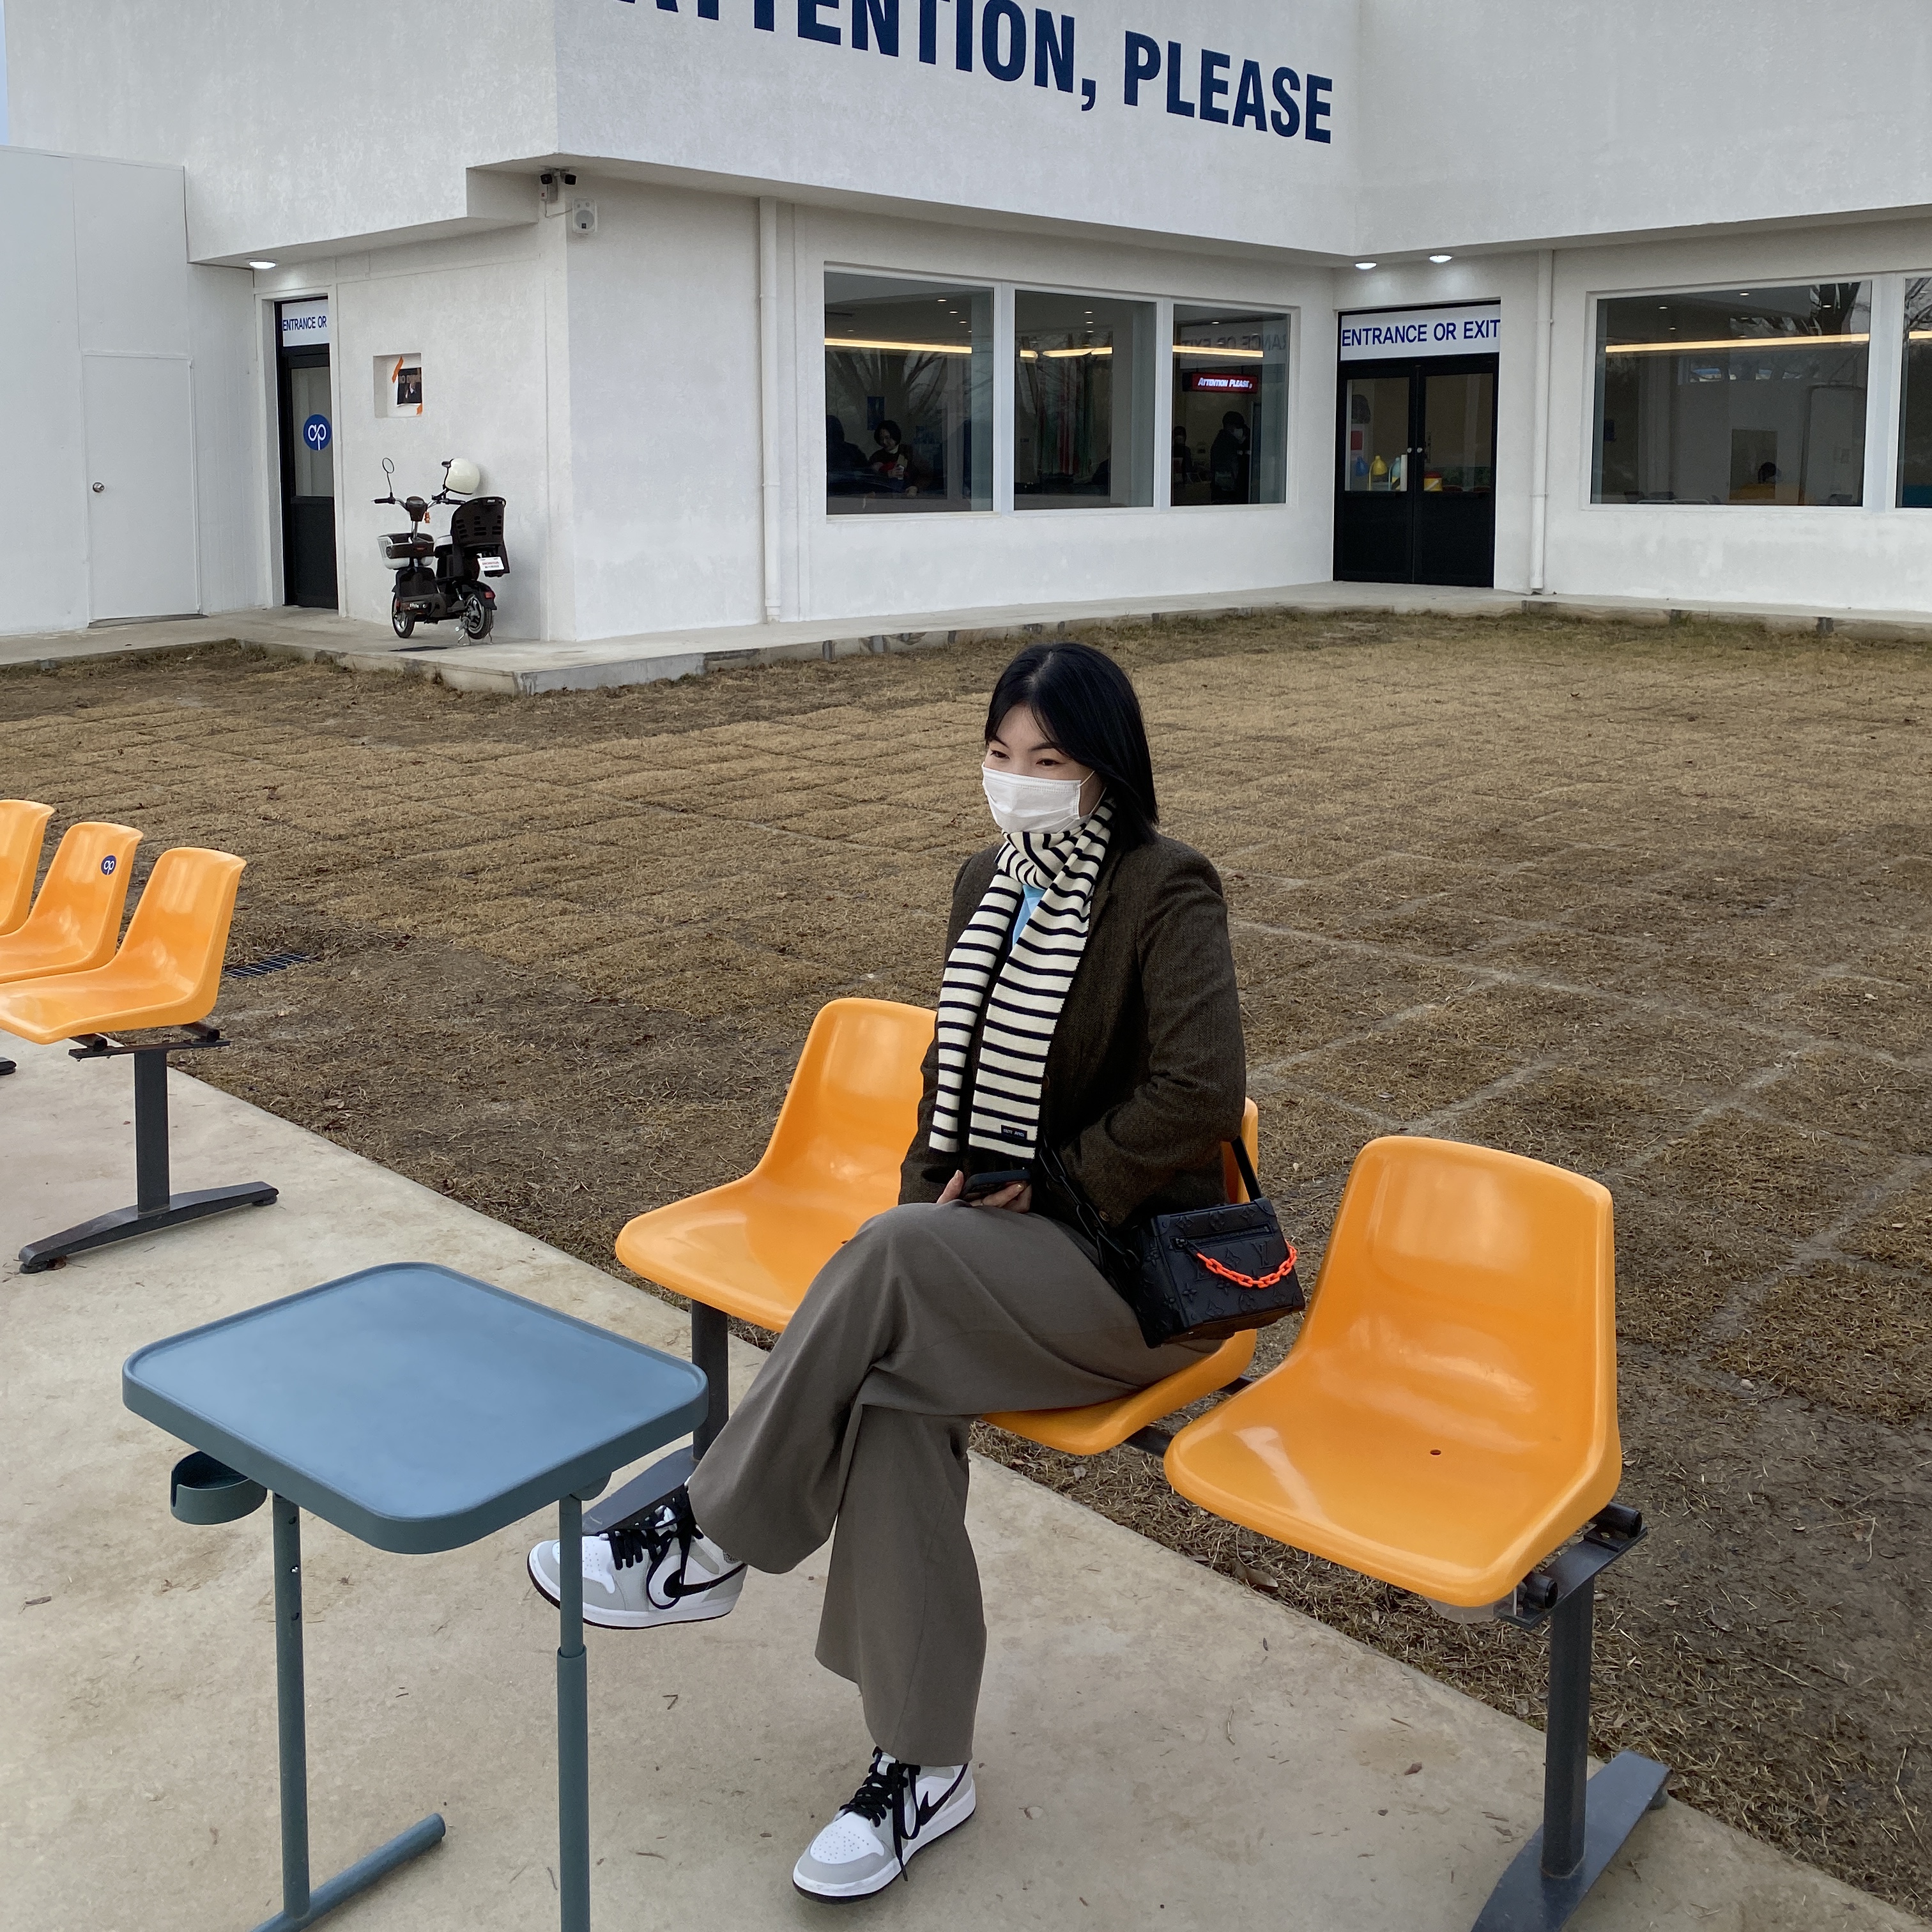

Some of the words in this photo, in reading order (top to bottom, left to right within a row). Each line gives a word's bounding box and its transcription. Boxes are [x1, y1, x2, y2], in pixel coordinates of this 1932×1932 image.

[617, 0, 1096, 111] NTION,
[1124, 30, 1332, 144] PLEASE
[283, 317, 316, 332] ENTRANCE
[318, 316, 327, 328] OR
[1342, 324, 1427, 347] ENTRANCE
[1433, 323, 1457, 342] OR
[1463, 319, 1501, 340] EXIT
